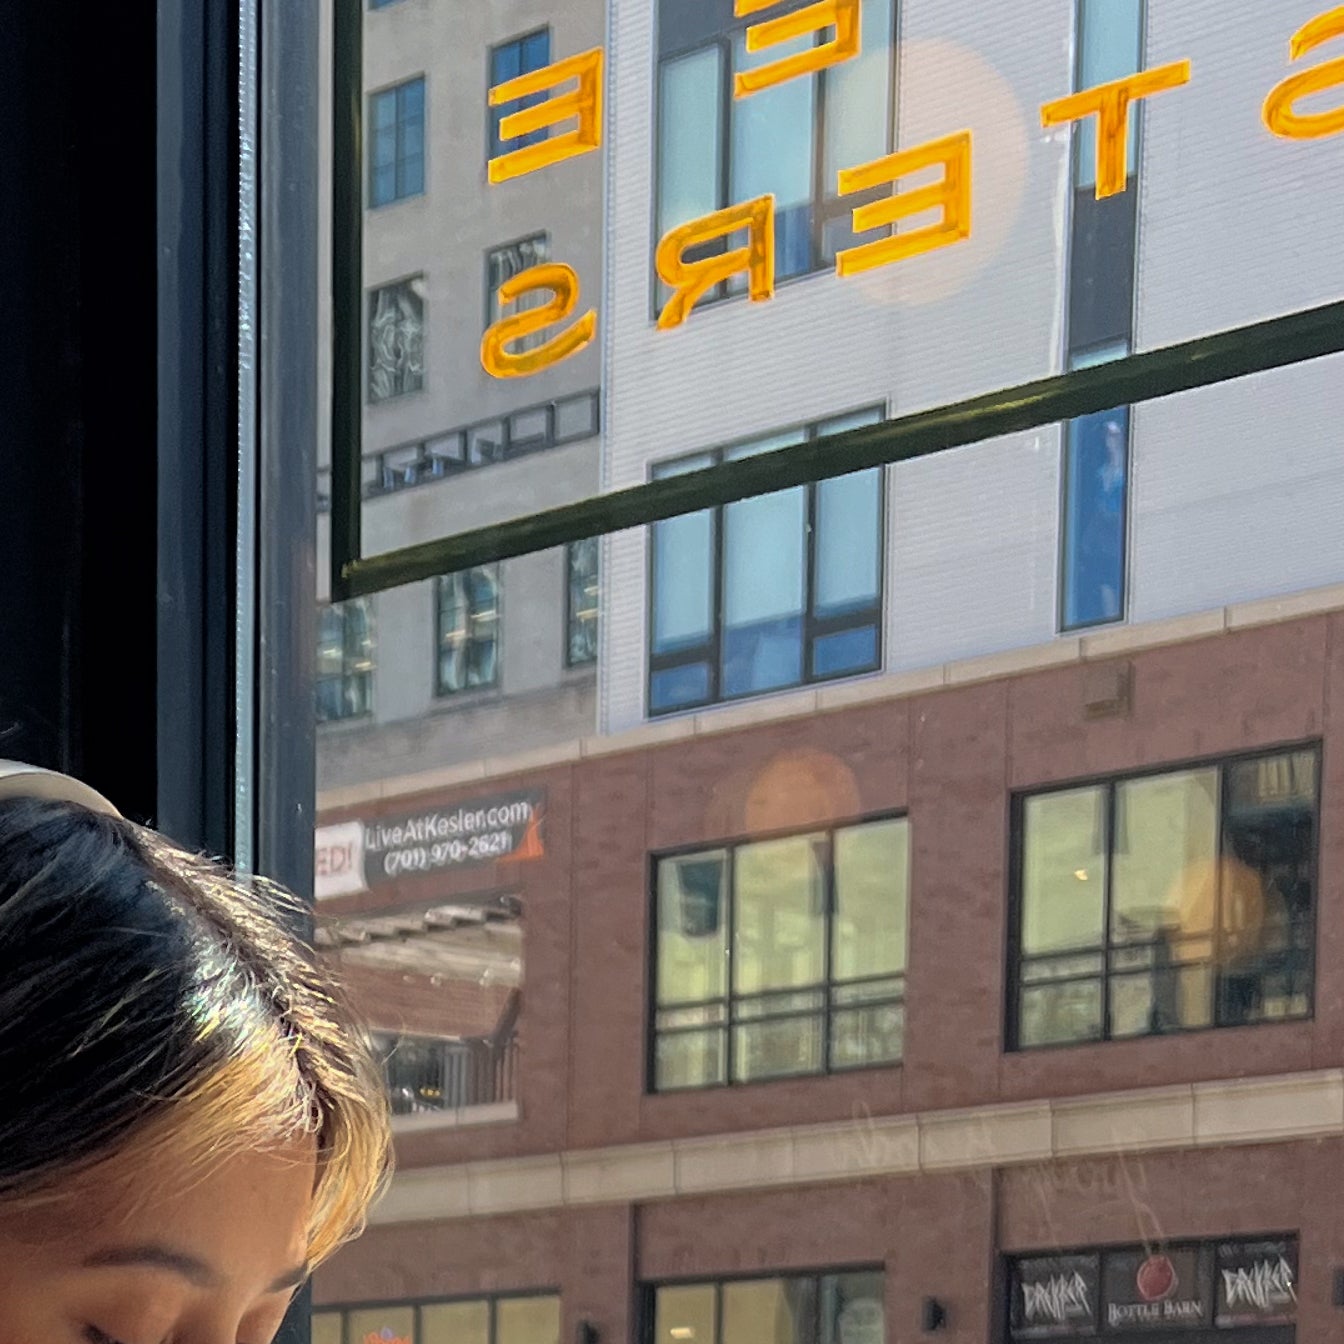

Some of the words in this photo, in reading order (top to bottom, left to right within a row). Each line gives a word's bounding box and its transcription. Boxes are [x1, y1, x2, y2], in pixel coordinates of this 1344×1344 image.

[365, 800, 532, 850] LiveAtKesler.com
[384, 847, 426, 876] (701)
[1164, 1299, 1203, 1318] BARN
